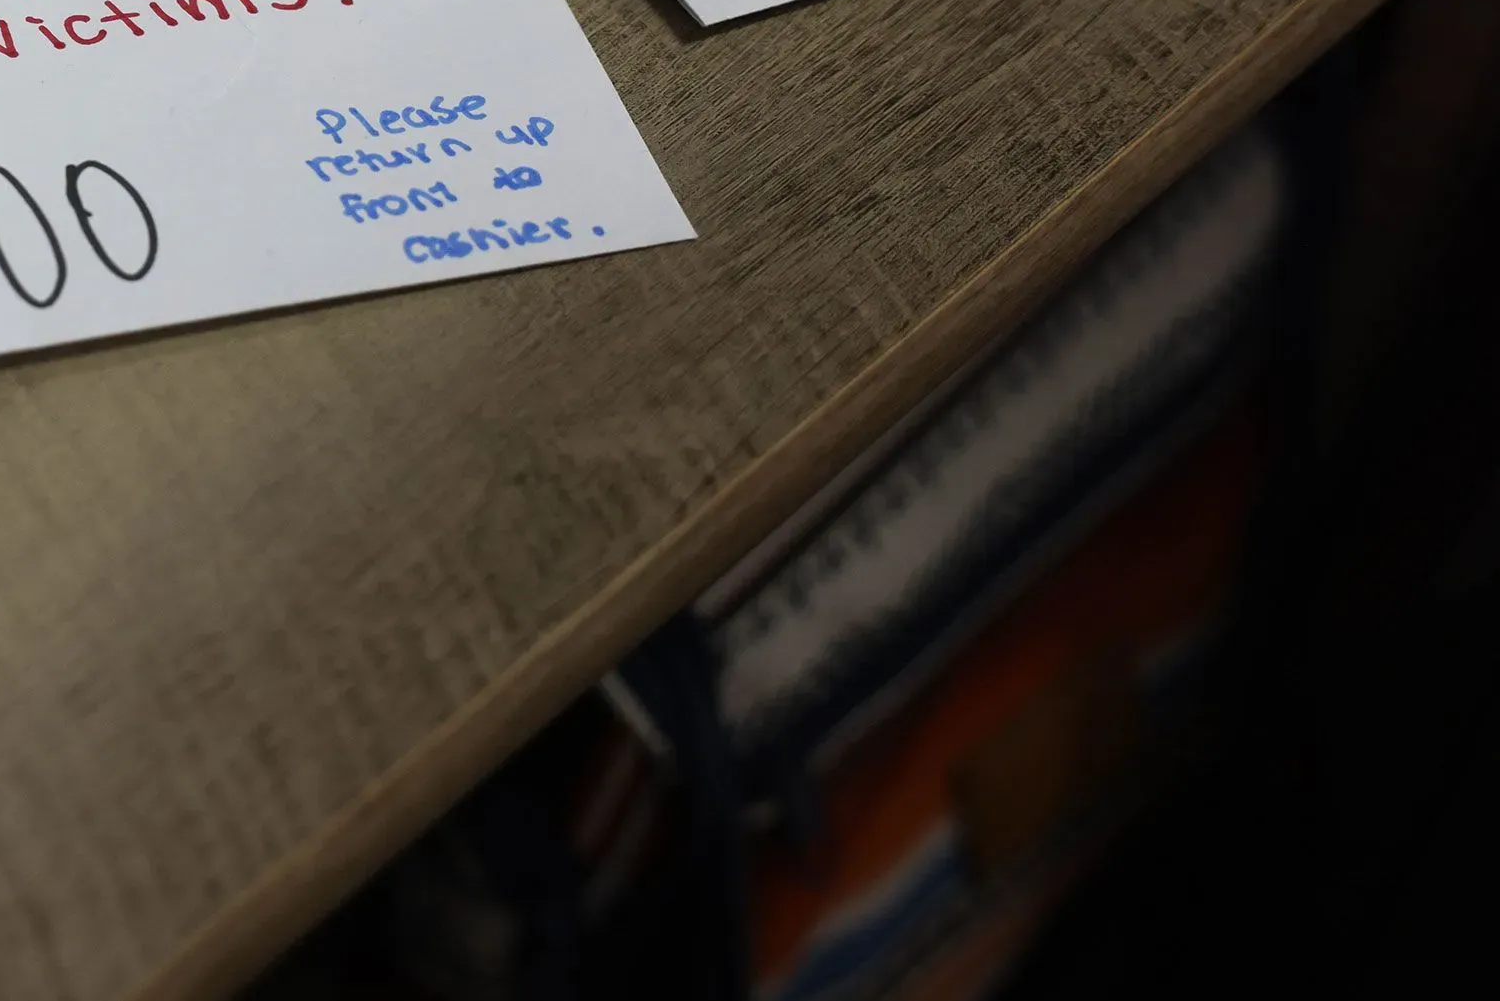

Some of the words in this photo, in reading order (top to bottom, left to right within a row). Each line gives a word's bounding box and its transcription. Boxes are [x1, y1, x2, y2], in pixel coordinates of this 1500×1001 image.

[316, 95, 487, 144] Please
[306, 138, 472, 183] return
[496, 117, 555, 147] up
[339, 182, 458, 224] front
[493, 166, 543, 191] to
